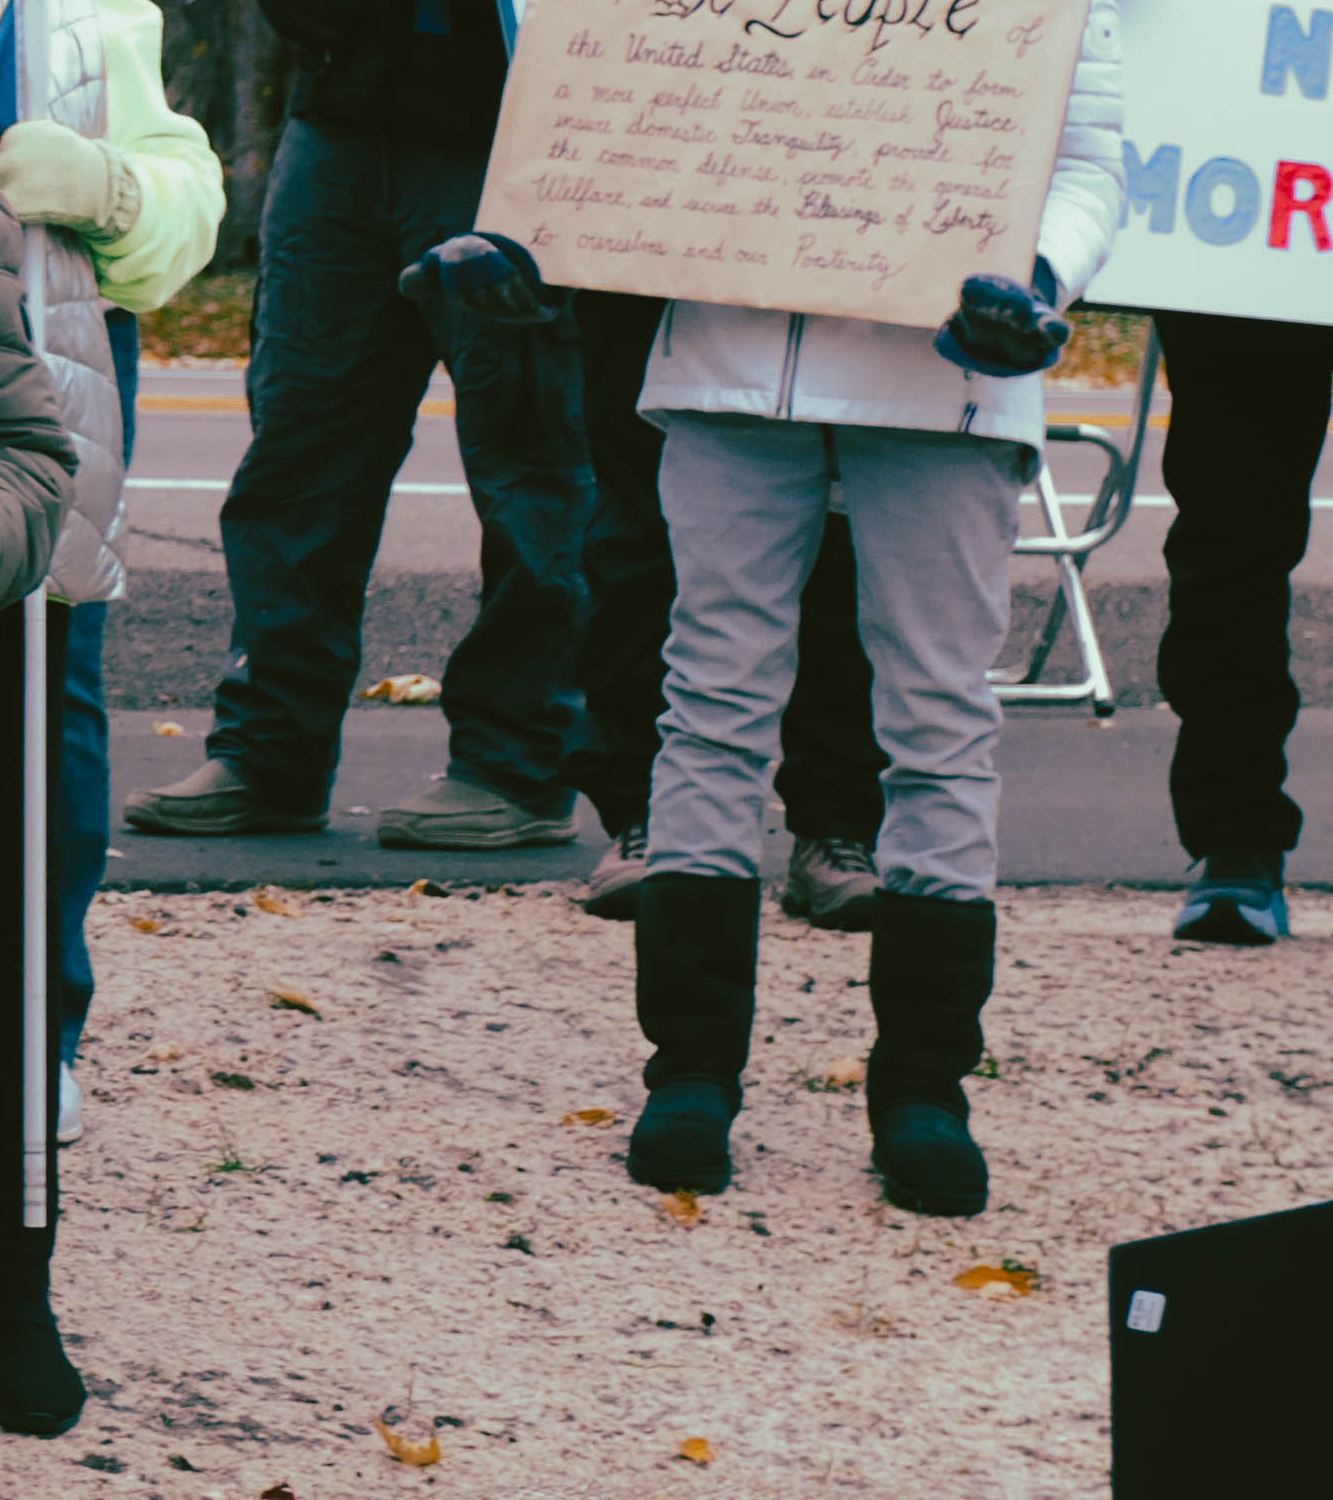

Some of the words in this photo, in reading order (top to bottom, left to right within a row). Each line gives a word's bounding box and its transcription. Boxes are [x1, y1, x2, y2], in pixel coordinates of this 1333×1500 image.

[566, 28, 605, 59] the
[625, 32, 705, 70] United
[547, 139, 582, 161] the
[529, 220, 560, 247] to
